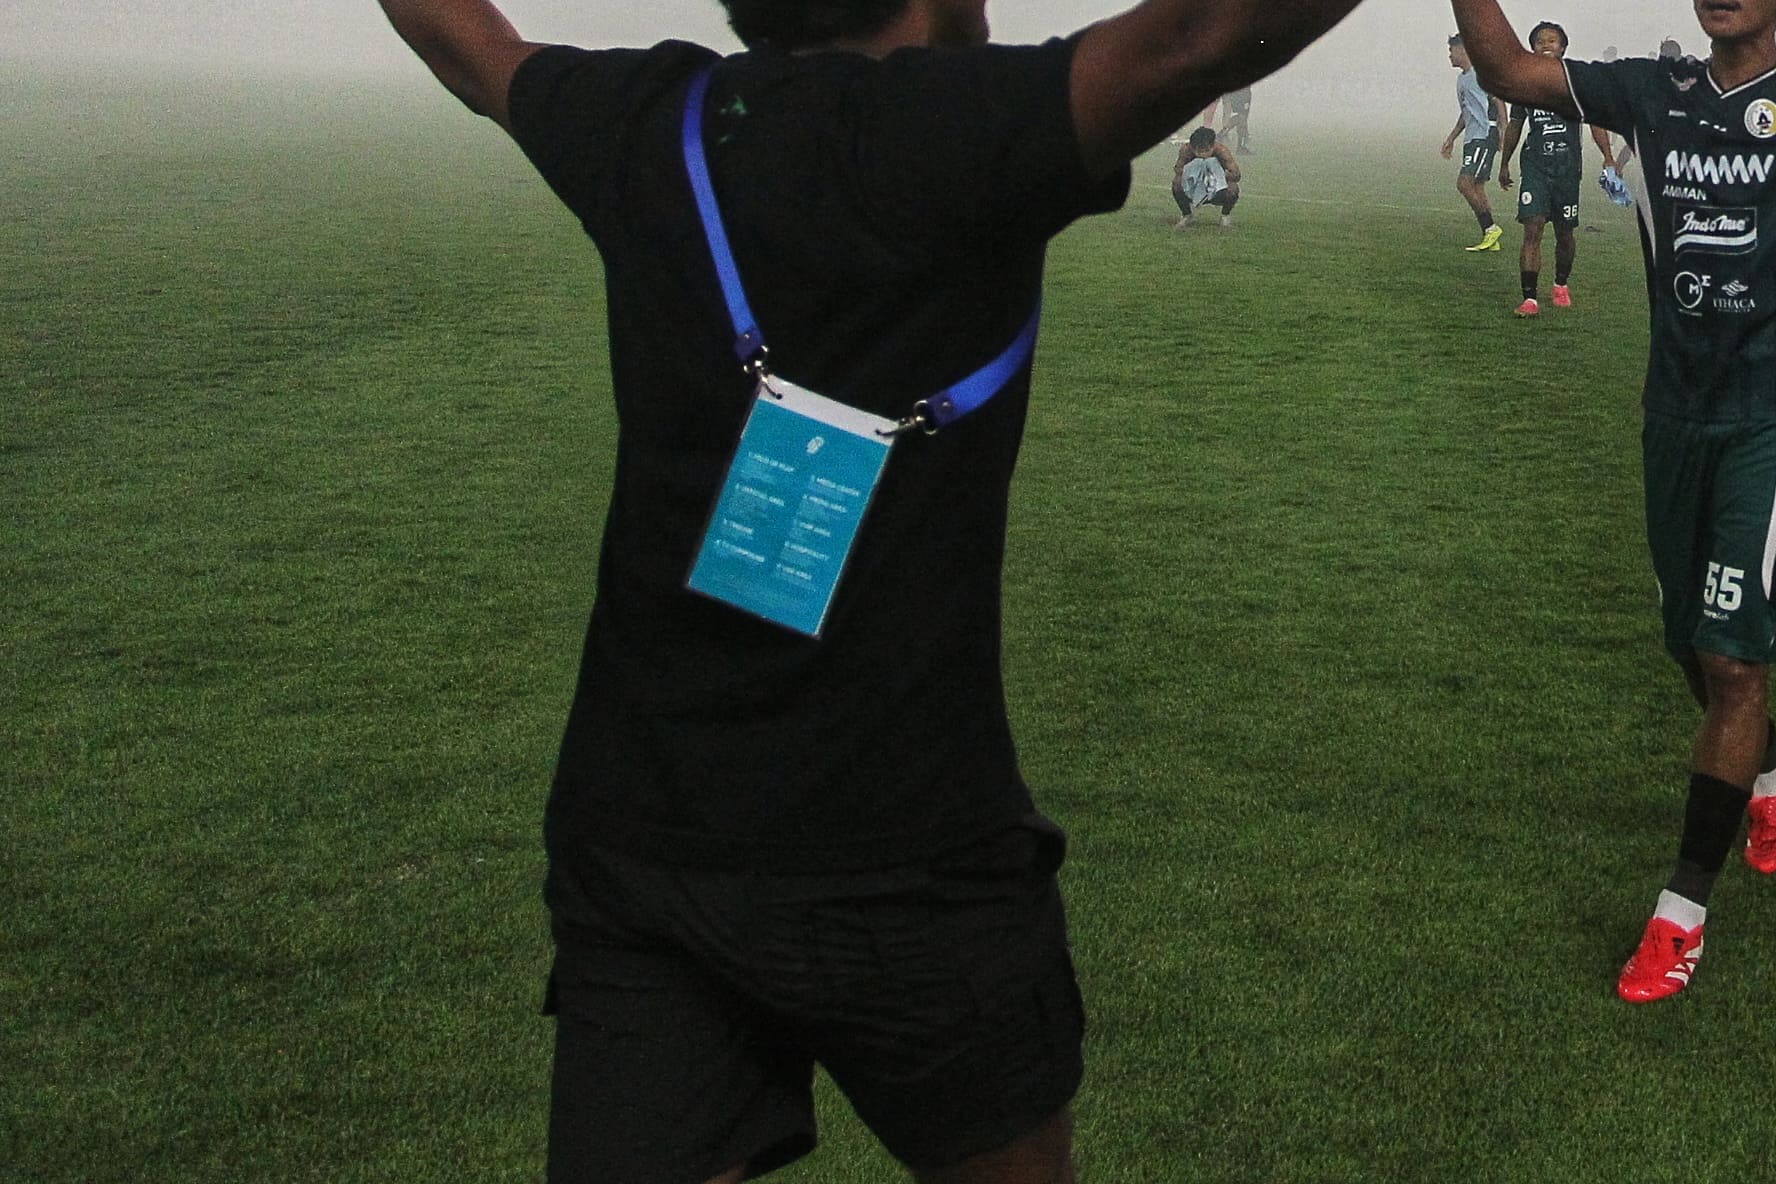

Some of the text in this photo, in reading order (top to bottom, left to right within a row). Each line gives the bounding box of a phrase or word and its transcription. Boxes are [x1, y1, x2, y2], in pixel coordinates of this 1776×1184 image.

[1662, 185, 1708, 201] AMMAN
[1712, 298, 1756, 310] ITHACA
[1703, 561, 1745, 612] 55
